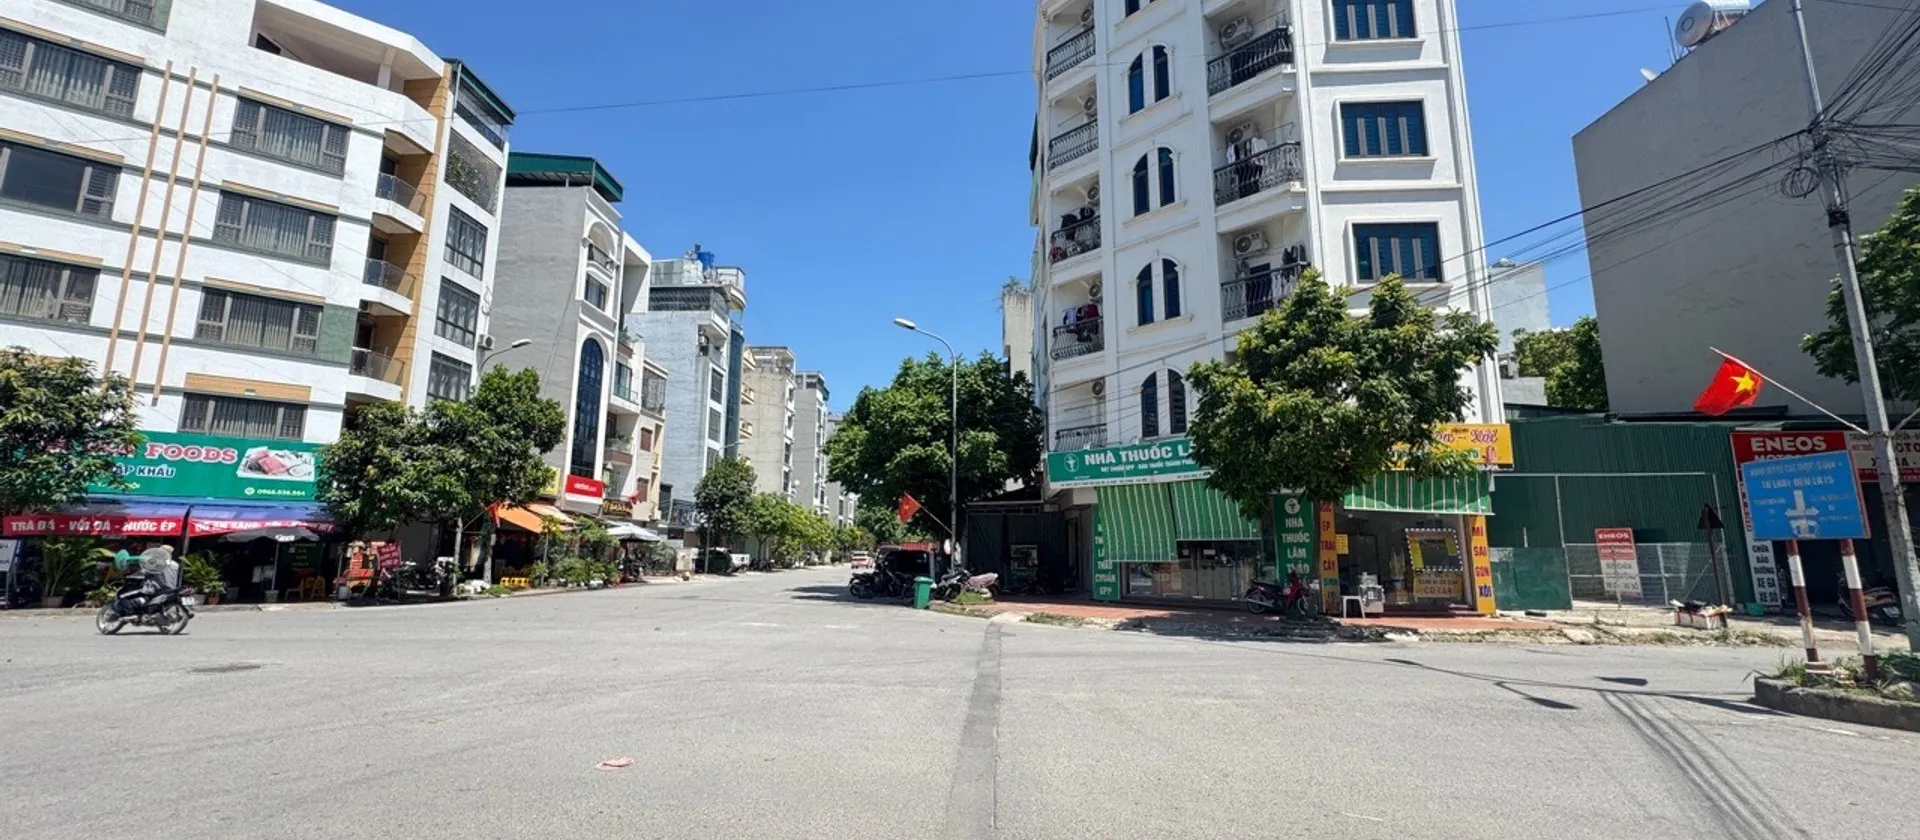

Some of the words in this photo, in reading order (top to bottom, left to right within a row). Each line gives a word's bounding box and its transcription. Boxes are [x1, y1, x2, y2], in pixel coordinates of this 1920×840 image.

[1750, 436, 1827, 452] ENEOS
[145, 443, 239, 463] FOODS
[1085, 453, 1115, 465] NHÀ
[1119, 443, 1172, 462] THUỐC
[11, 519, 34, 531] TRÀ
[160, 518, 177, 531] ÉP
[1285, 515, 1305, 528] NHÀ
[1282, 529, 1310, 543] THUỐC
[1598, 532, 1630, 540] ENEOS
[1287, 546, 1306, 558] LÂM
